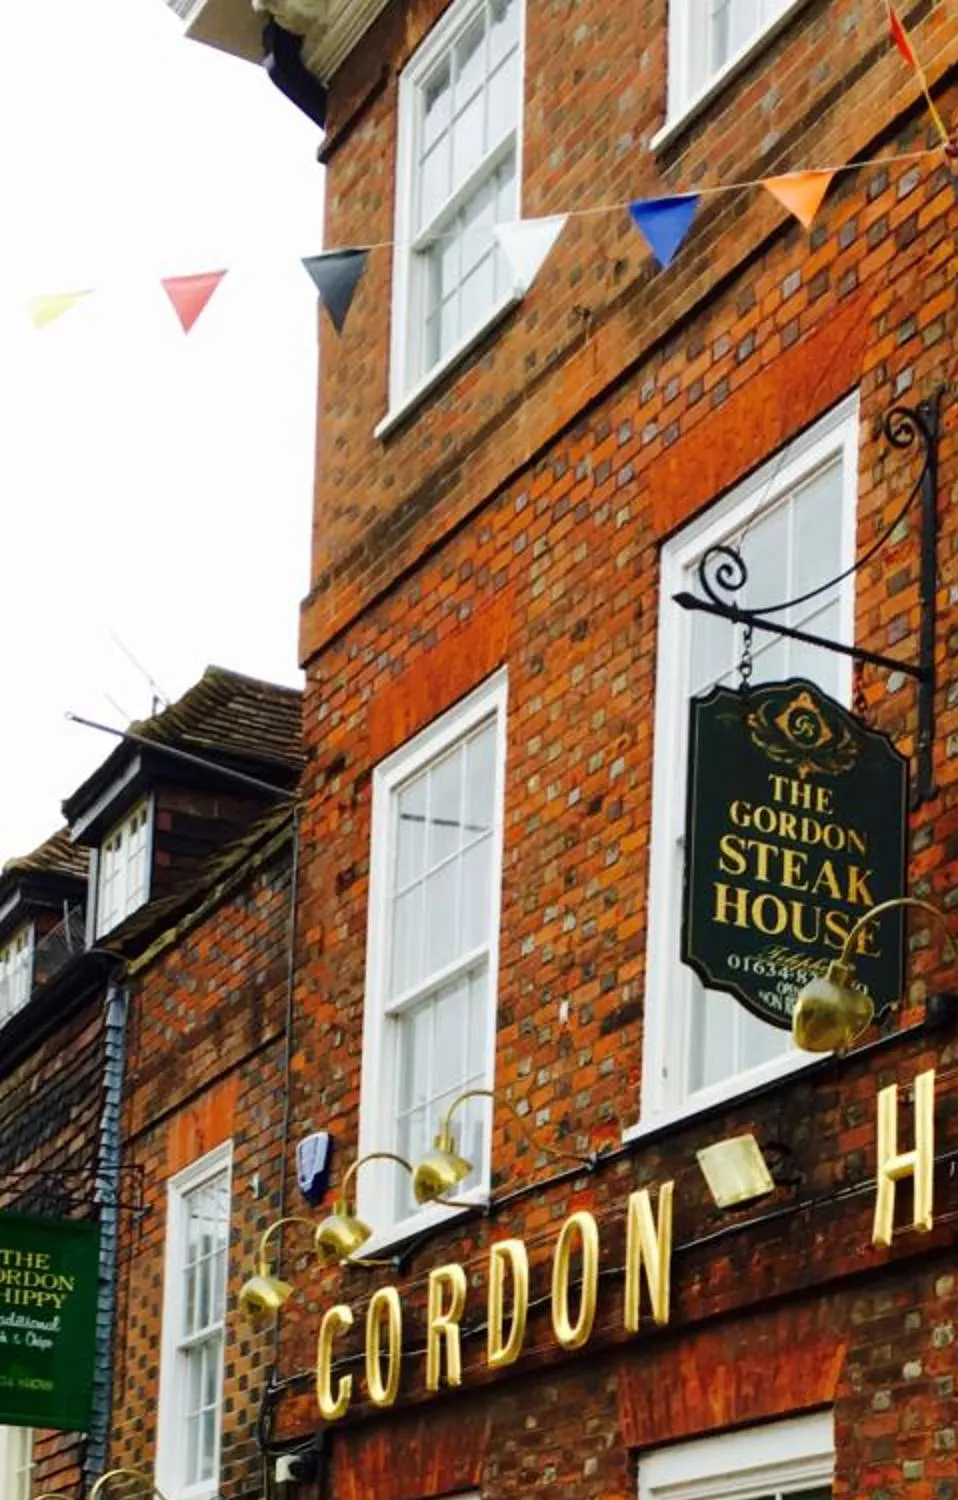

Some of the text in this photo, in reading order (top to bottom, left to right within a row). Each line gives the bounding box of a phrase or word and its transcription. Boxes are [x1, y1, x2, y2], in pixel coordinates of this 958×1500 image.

[768, 773, 834, 815] THE
[729, 800, 867, 852] GORDON
[718, 834, 876, 906] STEAK
[712, 882, 881, 957] HOUSE
[0, 1249, 51, 1270] THE
[0, 1286, 66, 1310] HIPPY
